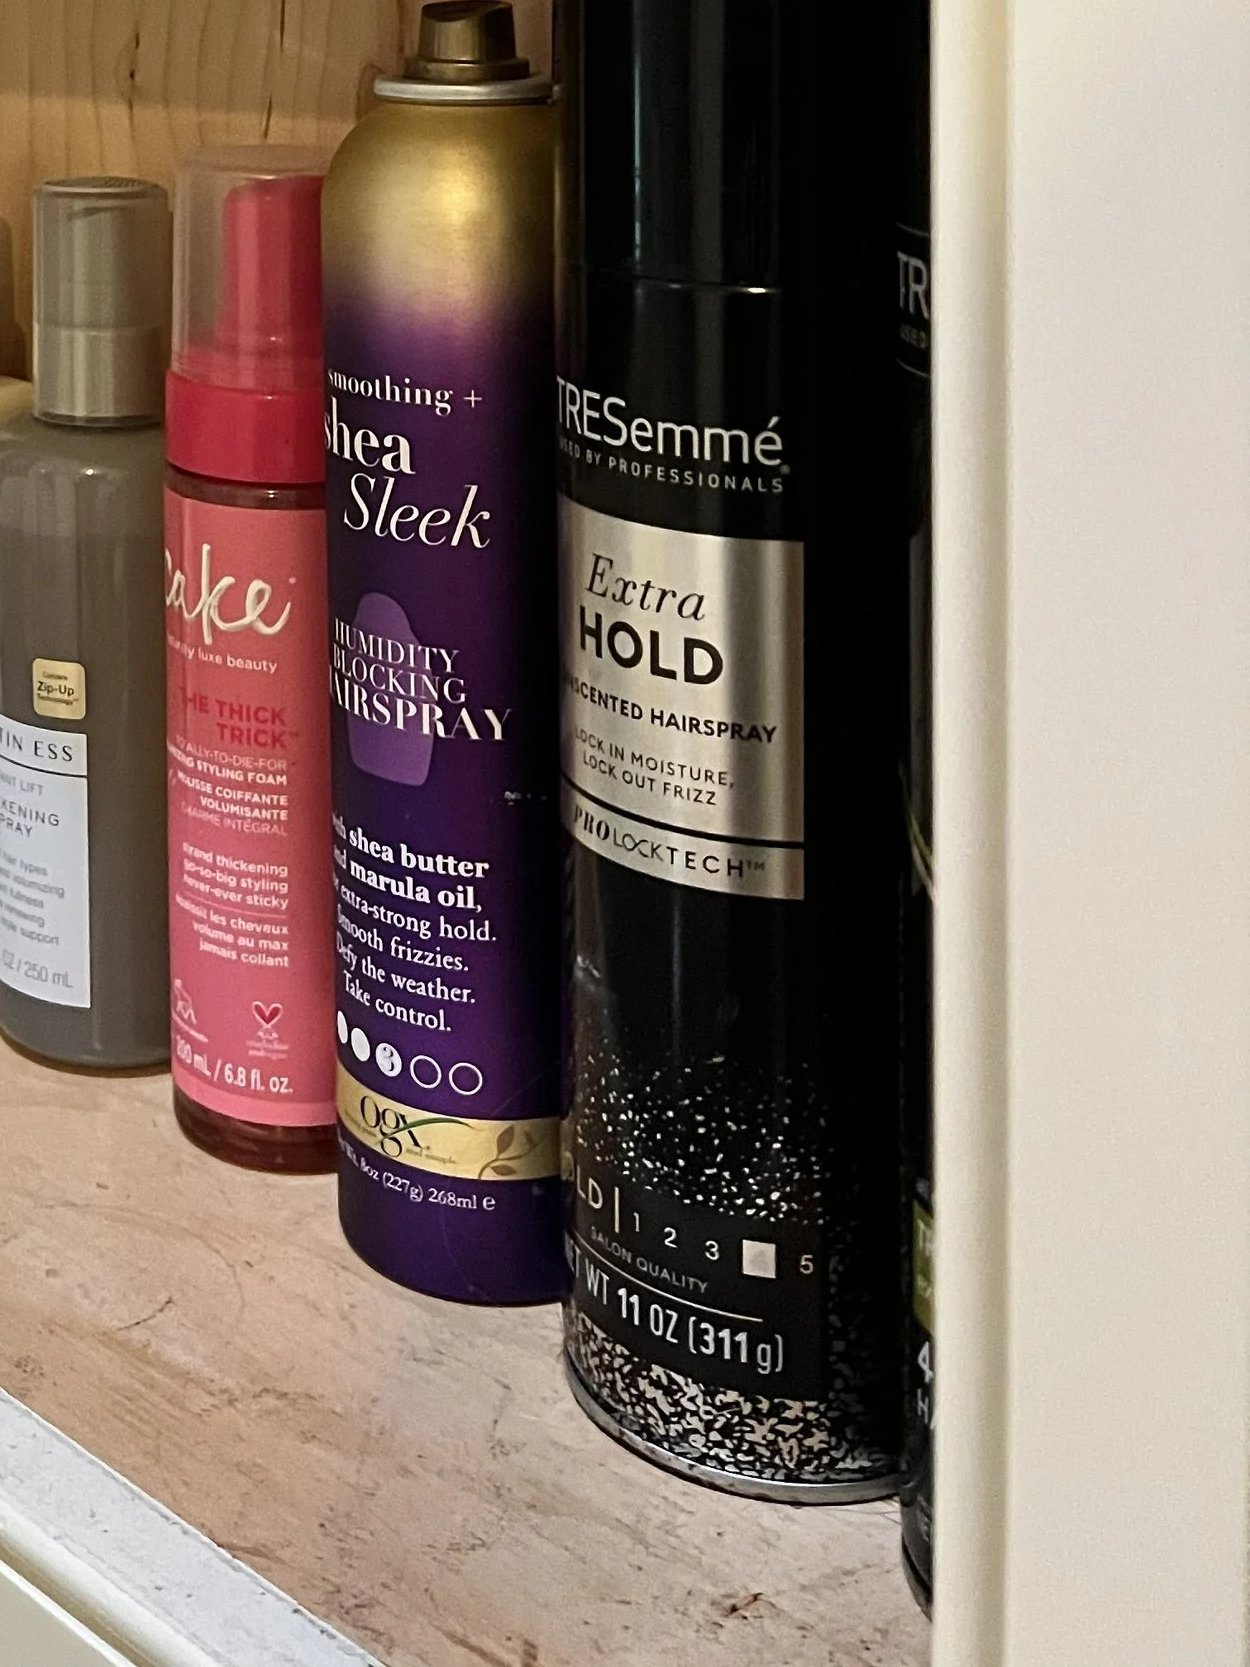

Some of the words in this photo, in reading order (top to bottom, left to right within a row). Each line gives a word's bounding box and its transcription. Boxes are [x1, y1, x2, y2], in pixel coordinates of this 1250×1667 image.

[328, 368, 454, 416] smoothing
[324, 395, 416, 475] shea
[556, 375, 783, 466] TRESemmé
[586, 448, 601, 465] BY
[608, 456, 783, 493] PROFESSIONALS
[343, 473, 491, 548] Sleek
[165, 543, 291, 645] ake
[585, 552, 705, 621] Extra
[198, 646, 223, 665] luxe
[226, 653, 278, 674] beauty
[334, 617, 460, 674] HUMIDITY
[579, 604, 723, 685] HOLD
[36, 680, 75, 697] Zip-Up
[333, 641, 467, 704] BLOCKING
[179, 686, 210, 715] THE
[215, 698, 287, 727] THICK
[650, 708, 777, 743] HAIRSPRAY
[34, 739, 74, 762] ESS
[196, 759, 244, 782] STYLING
[247, 772, 287, 786] FOAM
[575, 725, 605, 755] LOCK
[609, 742, 625, 762] IN
[630, 751, 734, 790] MOISTURE,
[20, 779, 44, 796] LIFT
[215, 786, 288, 807] COIFFANTE
[583, 748, 618, 780] LOCK
[622, 770, 656, 792] OUT
[662, 781, 717, 806] FRIZZ
[199, 795, 288, 821] VOLUMISANTE
[216, 851, 288, 878] thickening
[349, 826, 395, 864] shea
[400, 842, 490, 878] butter
[240, 874, 288, 895] styling
[245, 893, 289, 911] sticky
[350, 859, 431, 904] marula
[437, 885, 482, 914] oil,
[193, 920, 235, 944] volume
[237, 933, 255, 948] au
[258, 938, 288, 951] max
[210, 908, 227, 928] les
[230, 917, 288, 935] cheveux
[340, 884, 432, 940] extra-strong
[439, 915, 497, 942] hold.
[199, 938, 238, 961] jamais
[240, 949, 289, 968] collant
[337, 903, 384, 952] Smooth
[390, 935, 469, 972] frizzies.
[24, 959, 48, 983] 250
[51, 970, 74, 988] mL
[336, 930, 358, 972] Defy
[361, 955, 386, 983] the
[391, 970, 476, 1004] weather.
[343, 970, 371, 1007] Take
[375, 997, 452, 1032] control.
[224, 1063, 247, 1087] 6.8
[250, 1068, 266, 1091] fl.
[268, 1076, 294, 1094] oz.
[382, 1172, 424, 1203] (227g)
[428, 1187, 478, 1210] 268ml
[590, 1225, 633, 1265] SALON
[635, 1255, 708, 1294] QUALITY
[633, 1212, 640, 1233] 1
[663, 1226, 678, 1248] 2
[704, 1240, 720, 1261] 3
[799, 1254, 814, 1275] 5
[585, 1257, 610, 1306] WT
[617, 1286, 640, 1327] 11
[650, 1303, 679, 1344] OZ
